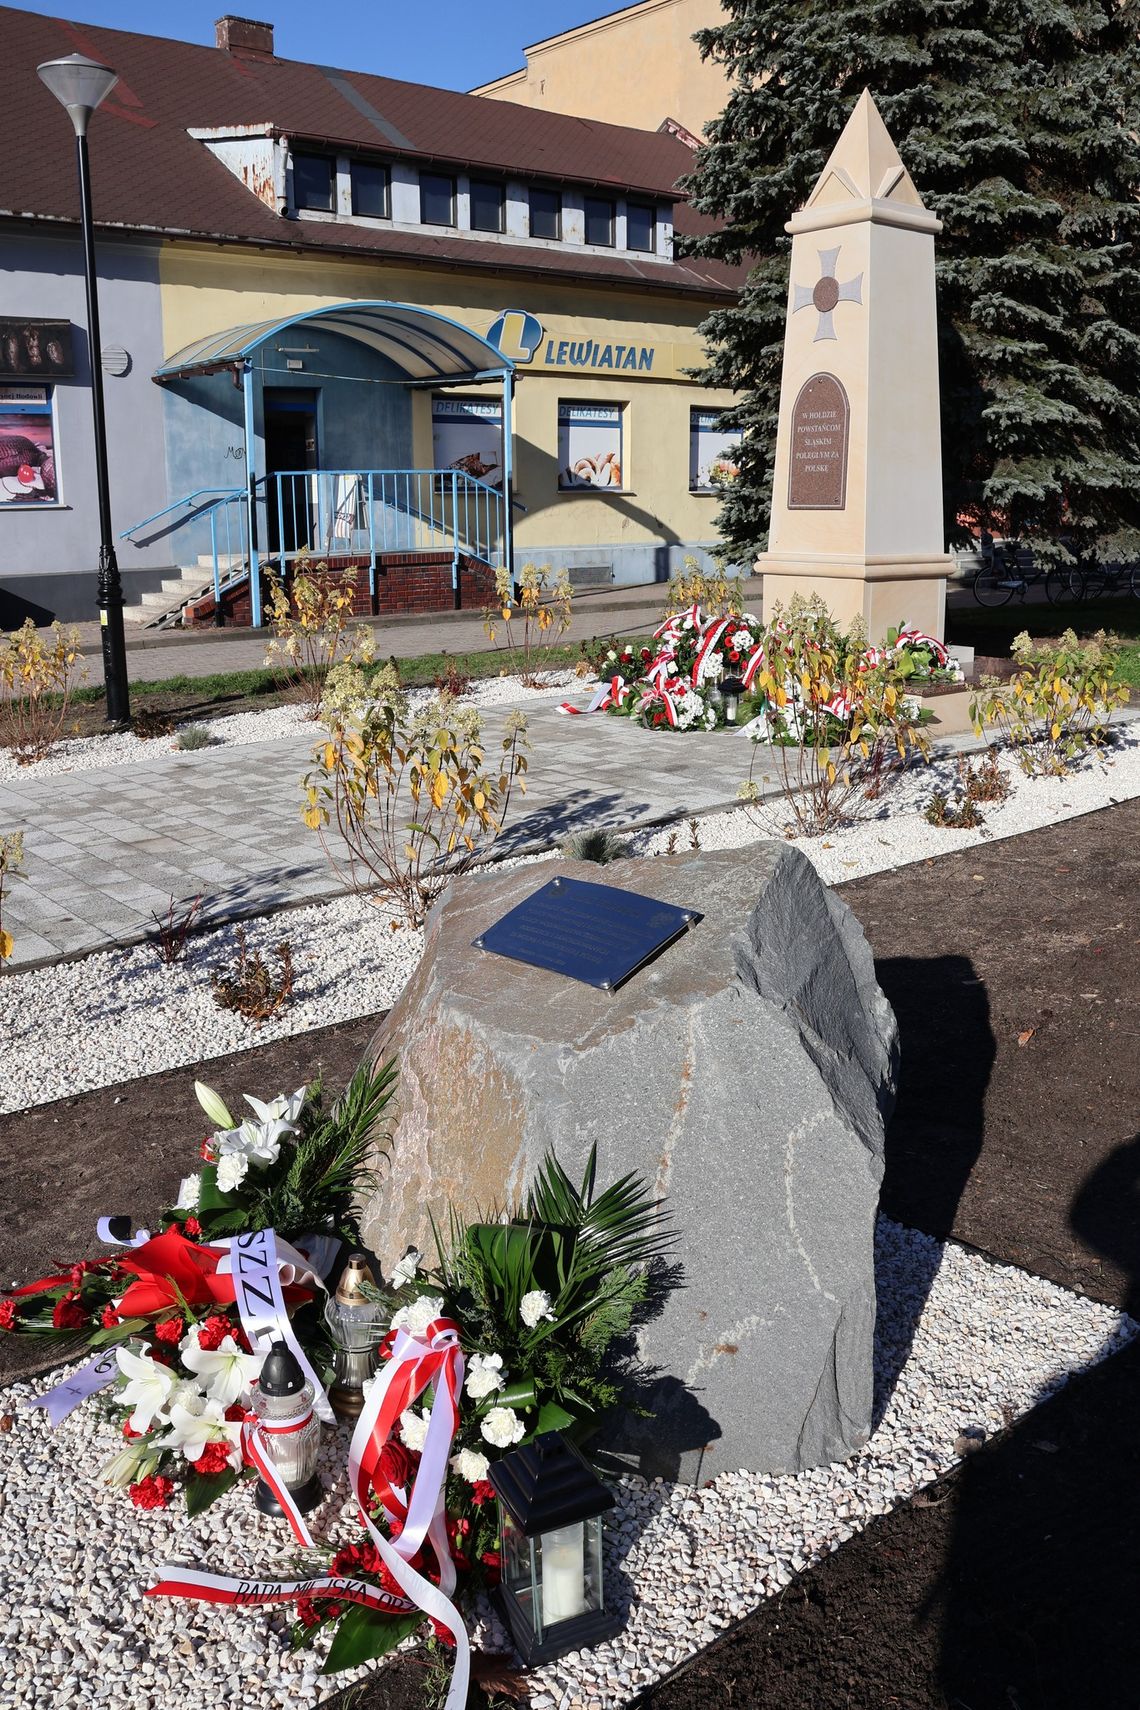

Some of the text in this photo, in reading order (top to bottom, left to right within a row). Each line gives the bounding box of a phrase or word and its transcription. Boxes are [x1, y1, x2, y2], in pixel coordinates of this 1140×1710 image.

[545, 339, 655, 370] LEWIATAN
[436, 402, 499, 415] DELIKATESY
[559, 406, 615, 419] DELIKATESY
[830, 451, 840, 459] ZA
[233, 1581, 282, 1602] RADA
[289, 1579, 367, 1600] MIEJSKA
